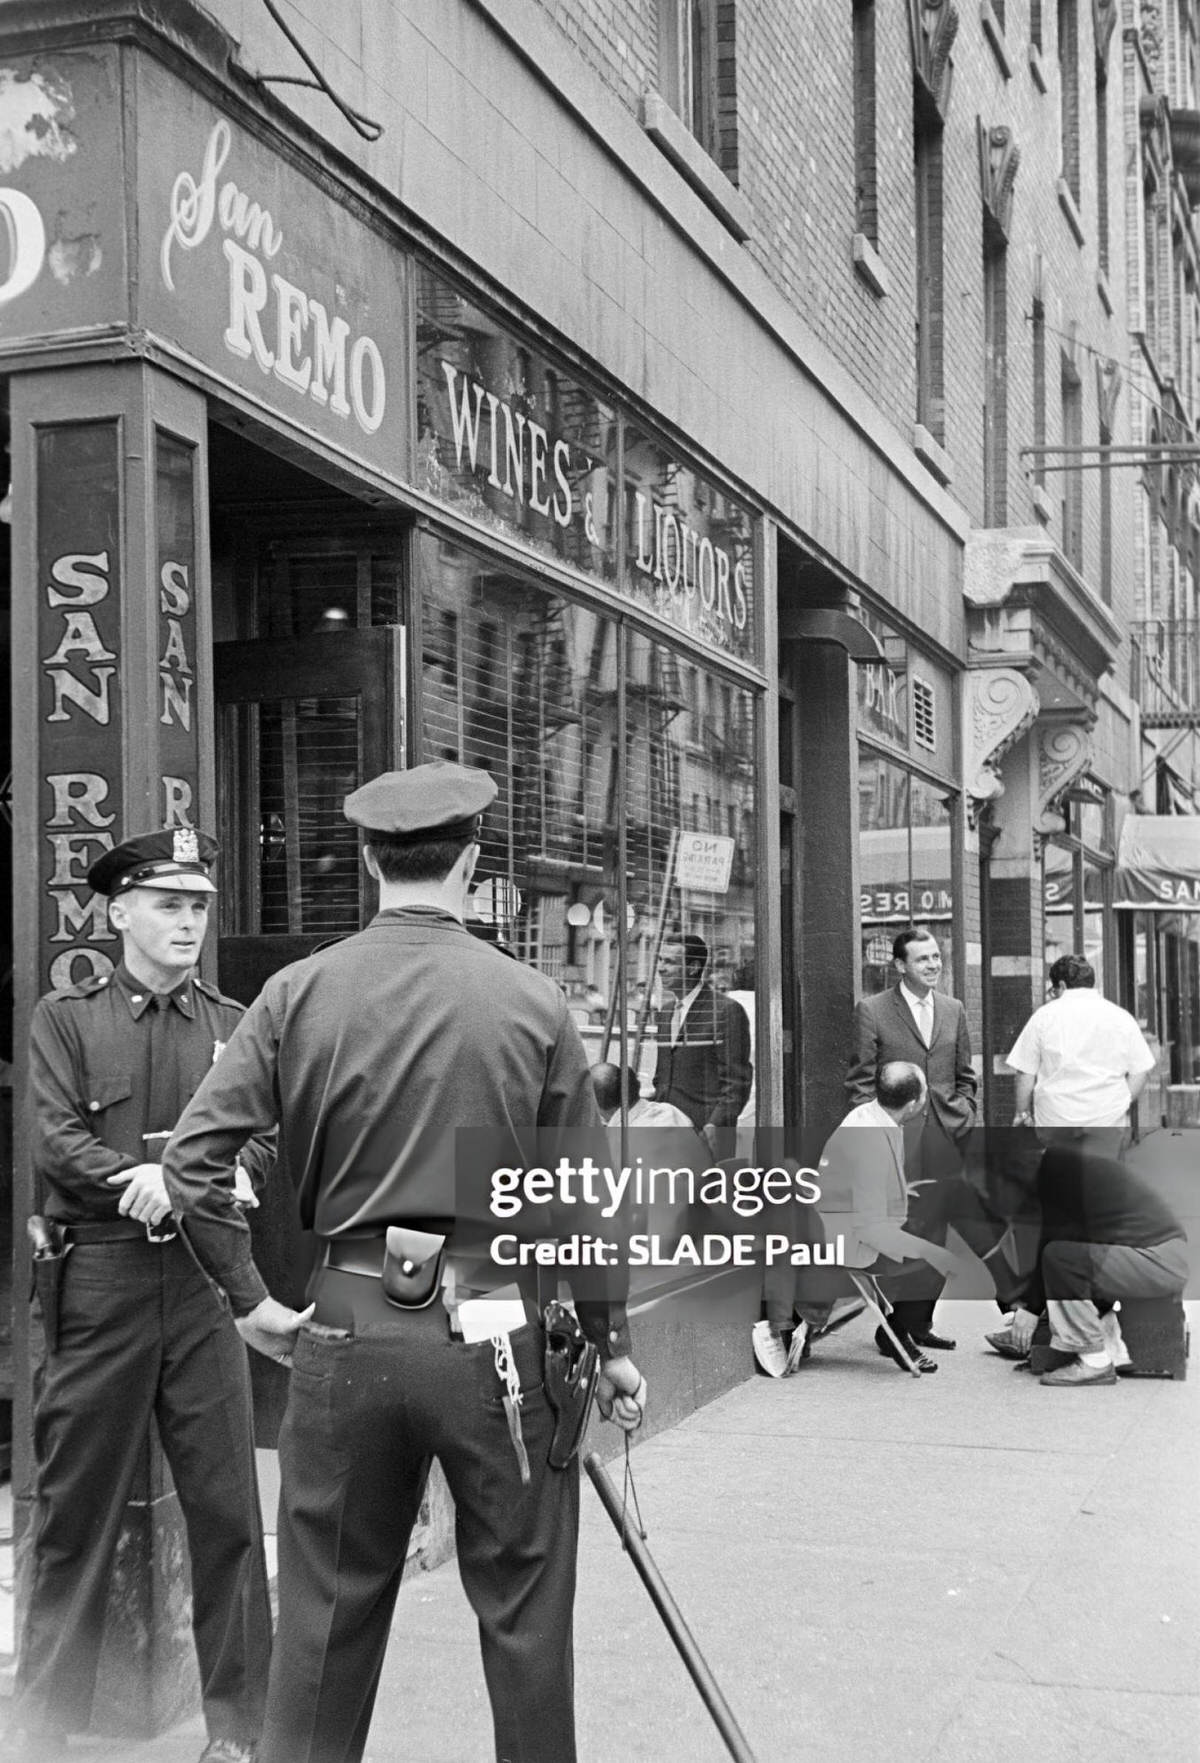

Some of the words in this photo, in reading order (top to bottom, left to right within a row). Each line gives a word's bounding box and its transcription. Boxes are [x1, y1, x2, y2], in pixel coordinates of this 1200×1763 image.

[161, 118, 283, 292] San
[222, 237, 386, 434] REMO
[440, 359, 574, 528] WINES
[634, 490, 749, 631] LIQUORS
[42, 550, 118, 726] SAN
[159, 560, 194, 733] SAN
[865, 663, 899, 724] BAR
[45, 772, 118, 992] REMO
